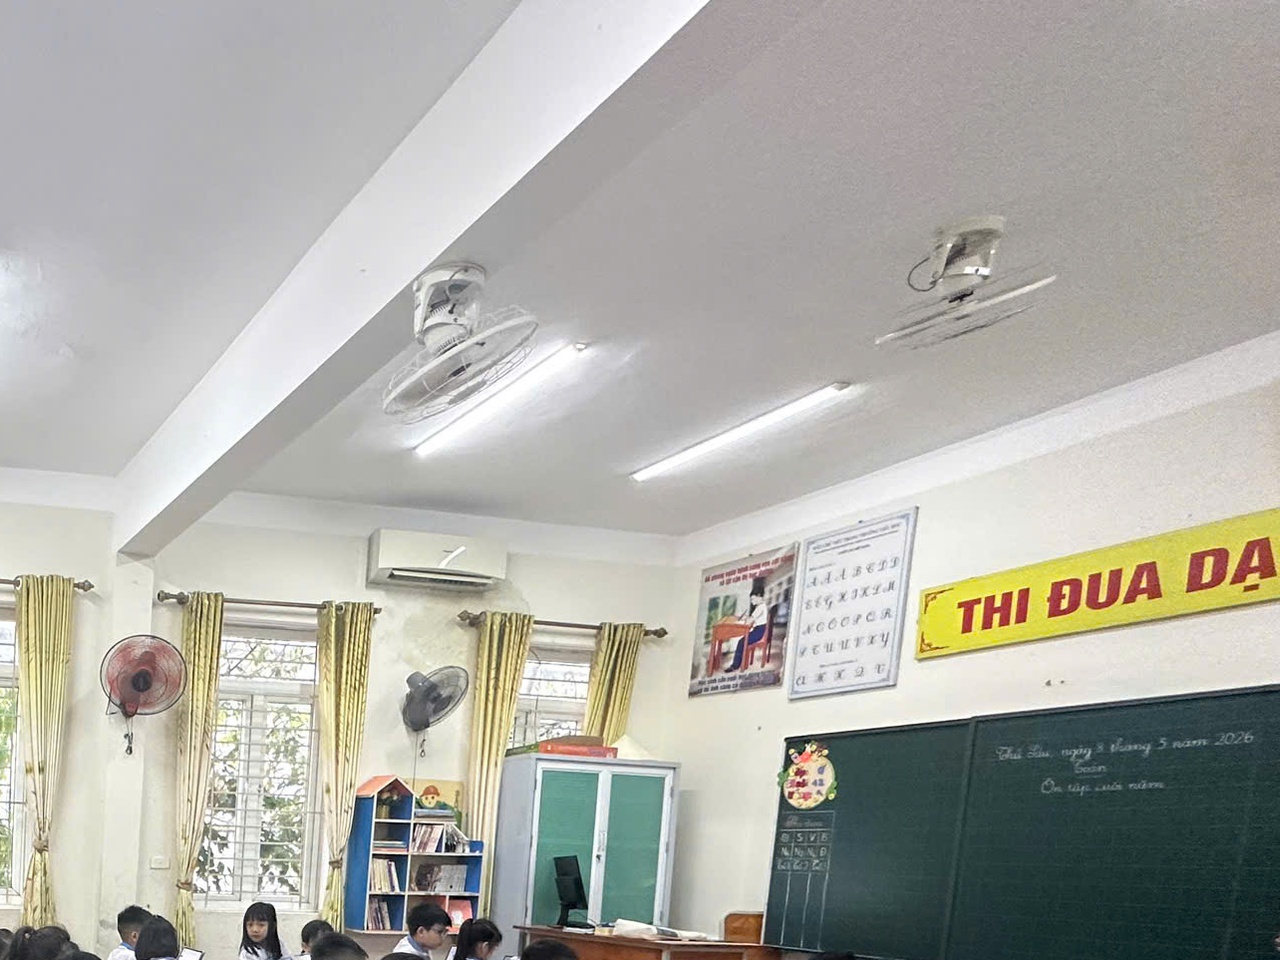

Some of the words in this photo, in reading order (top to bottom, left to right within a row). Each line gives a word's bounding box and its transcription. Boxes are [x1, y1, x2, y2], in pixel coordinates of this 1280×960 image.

[957, 587, 1030, 634] THI
[1047, 560, 1163, 619] ĐUA
[1185, 536, 1277, 593] DẠ
[1158, 737, 1167, 750] 5
[1214, 730, 1255, 746] 2026
